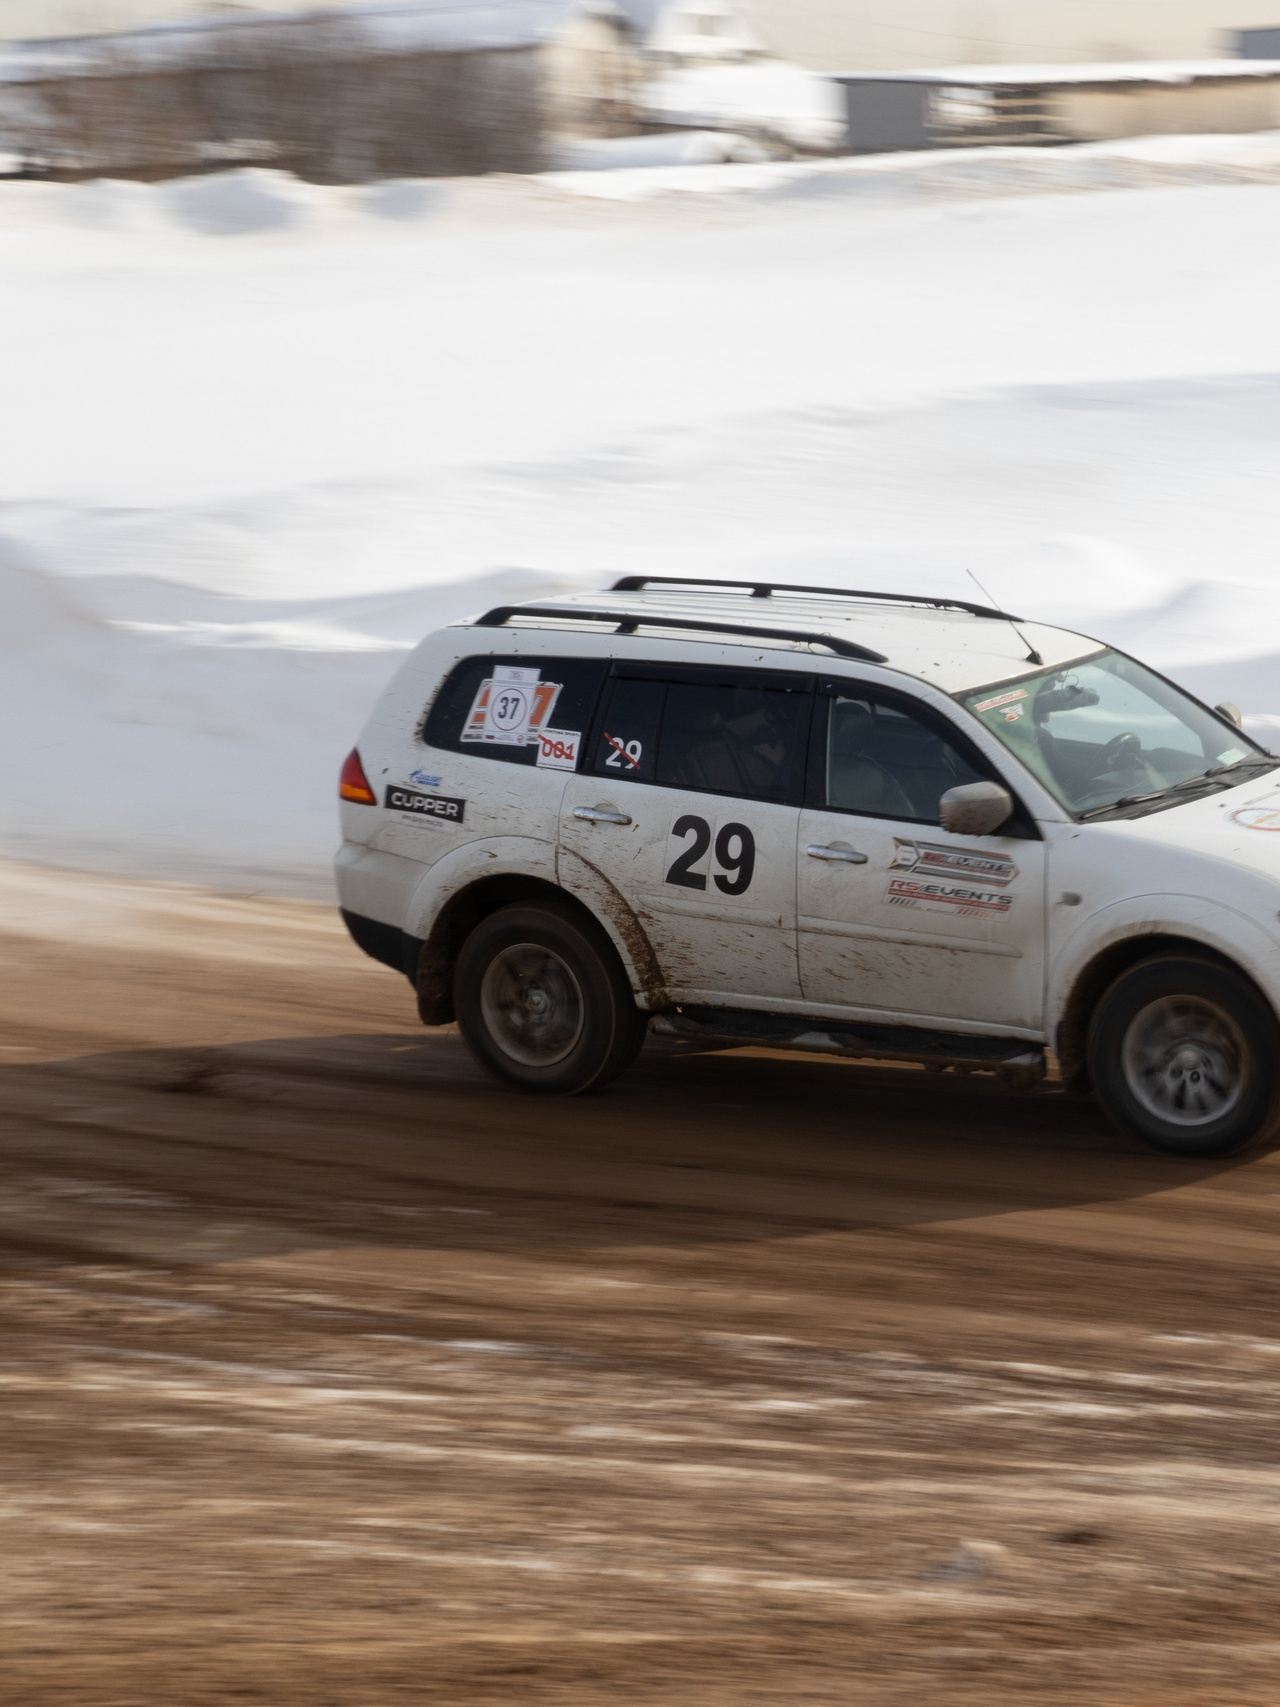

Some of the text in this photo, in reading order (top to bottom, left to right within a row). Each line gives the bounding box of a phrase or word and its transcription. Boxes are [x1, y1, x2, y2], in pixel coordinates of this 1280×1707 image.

[498, 696, 520, 720] 37
[541, 739, 575, 761] 001
[605, 737, 643, 769] 29
[391, 792, 459, 817] CUPPER
[665, 814, 756, 896] 29
